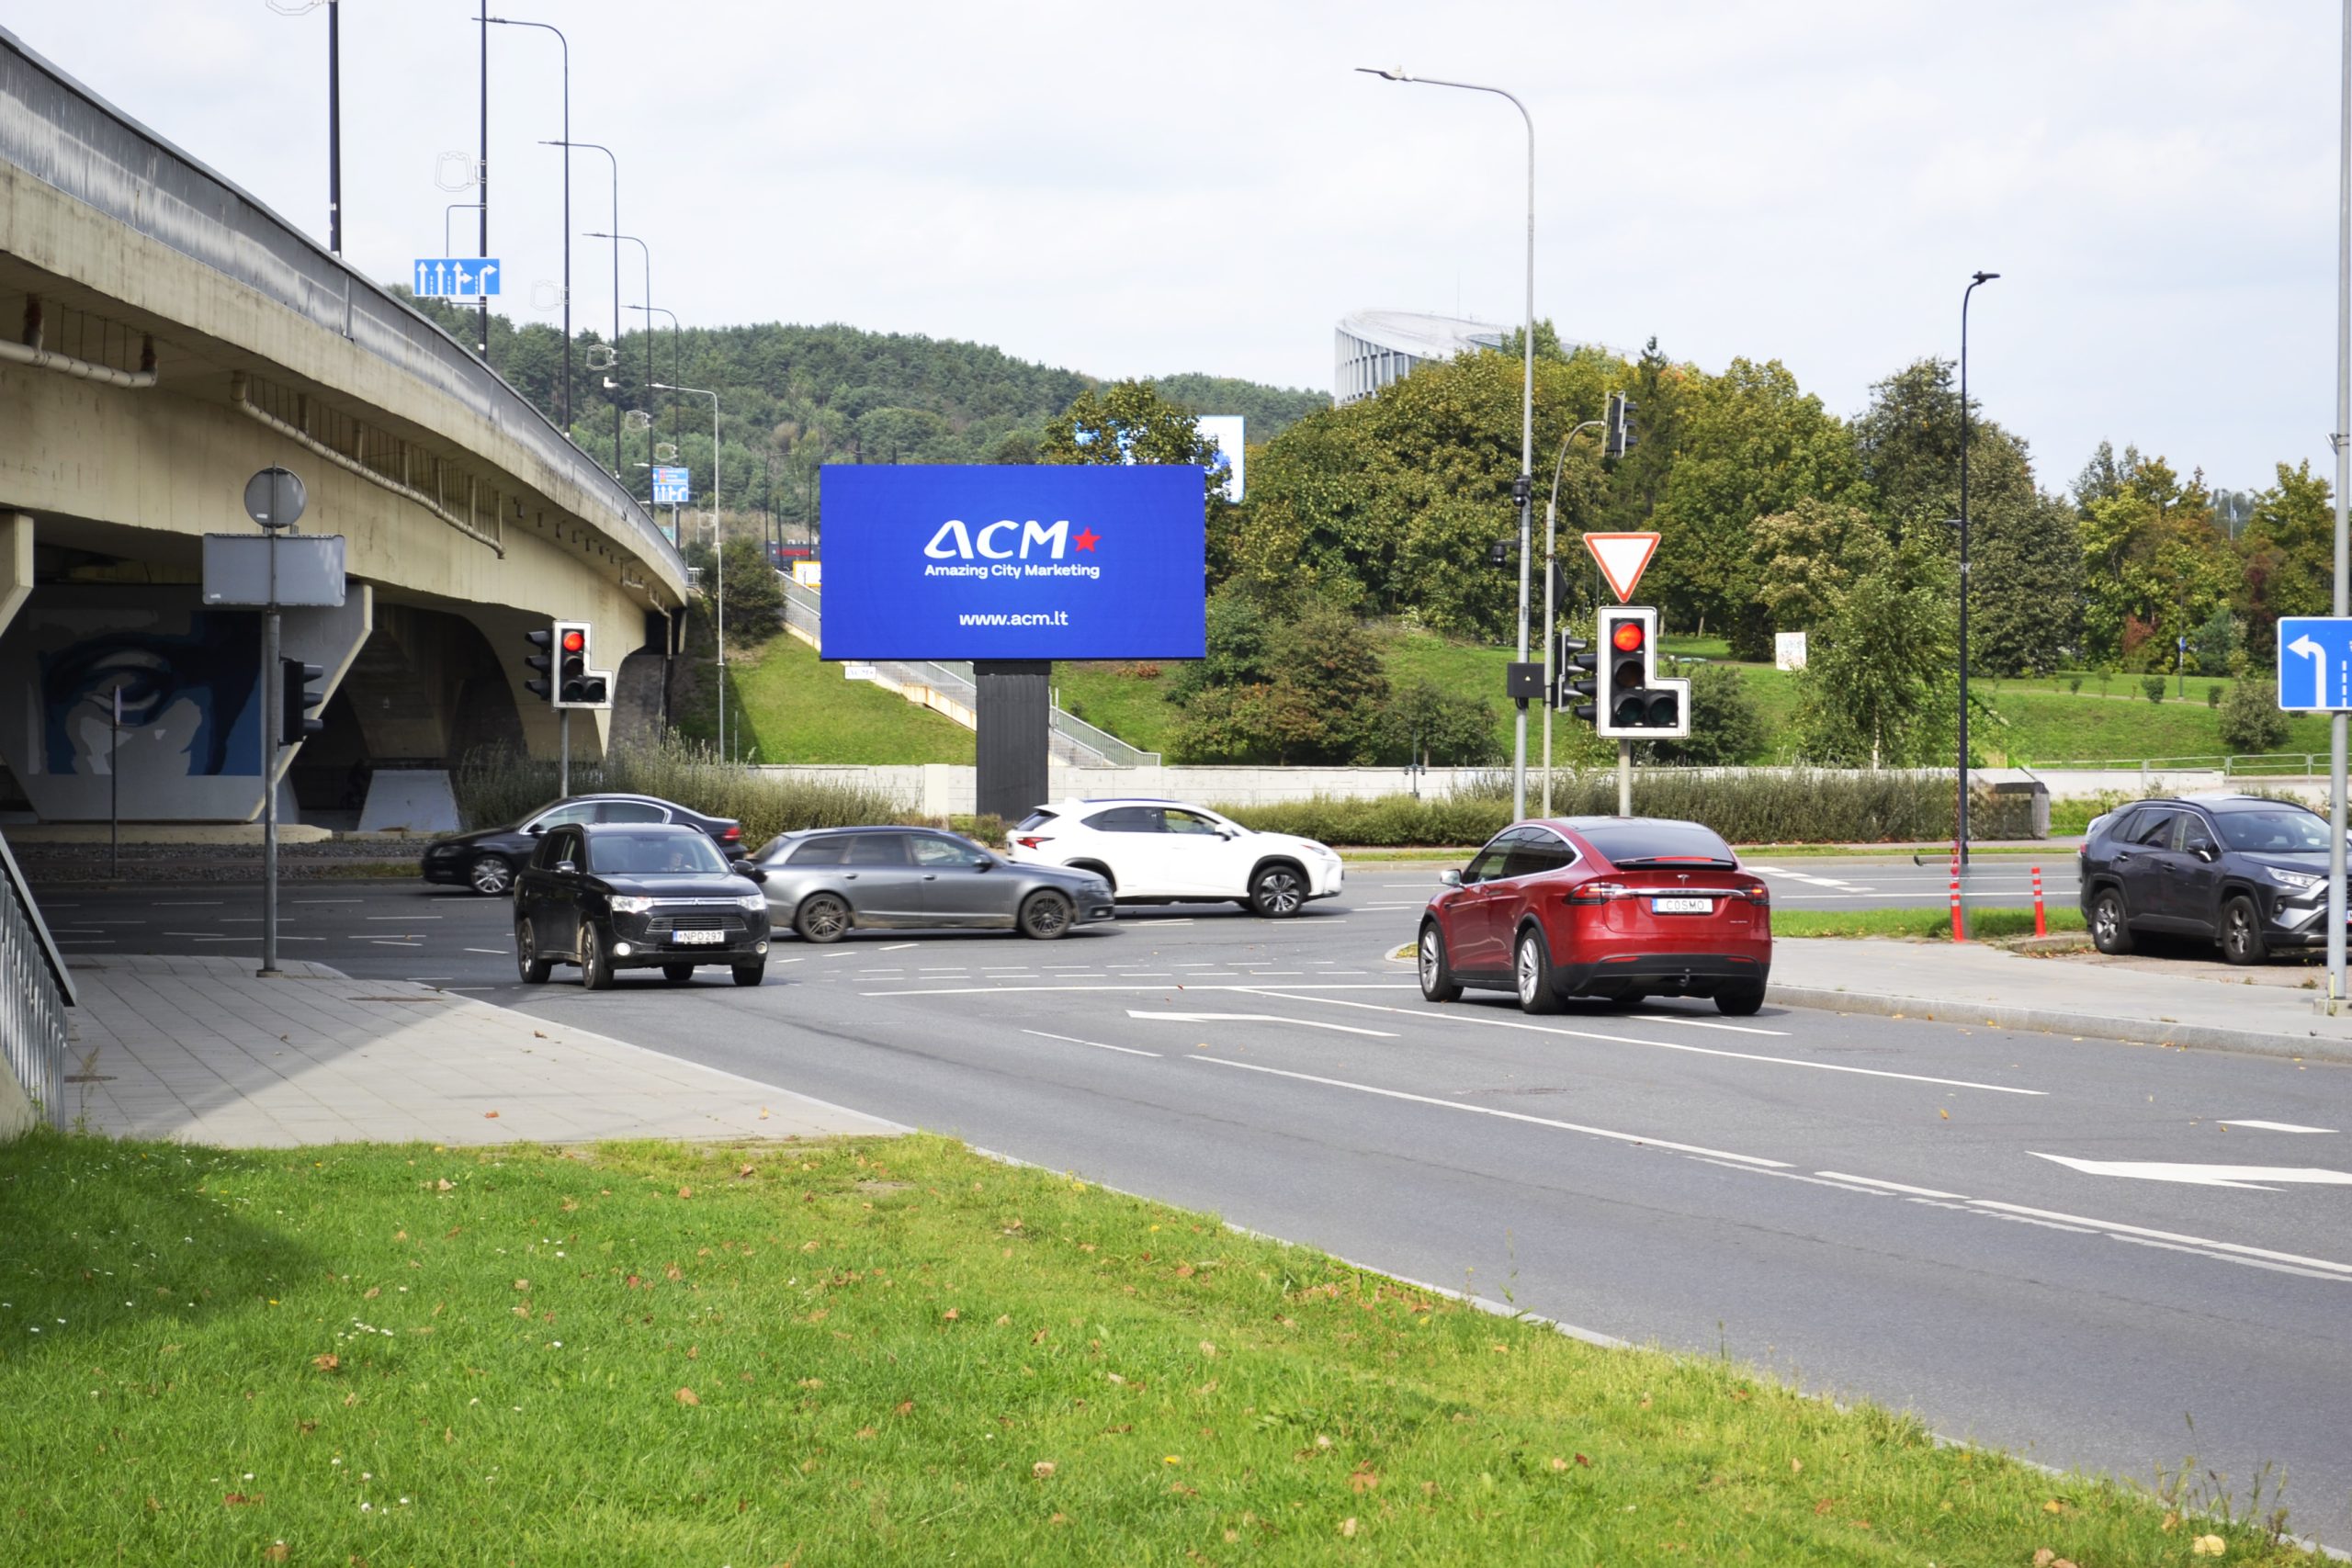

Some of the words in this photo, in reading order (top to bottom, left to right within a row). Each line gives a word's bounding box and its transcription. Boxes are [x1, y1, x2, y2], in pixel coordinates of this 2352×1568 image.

[923, 520, 1069, 558] ACM
[924, 564, 988, 579] Amazing
[991, 564, 1022, 579] City
[1024, 563, 1100, 579] Marketing
[959, 611, 1069, 626] www.acm.lt
